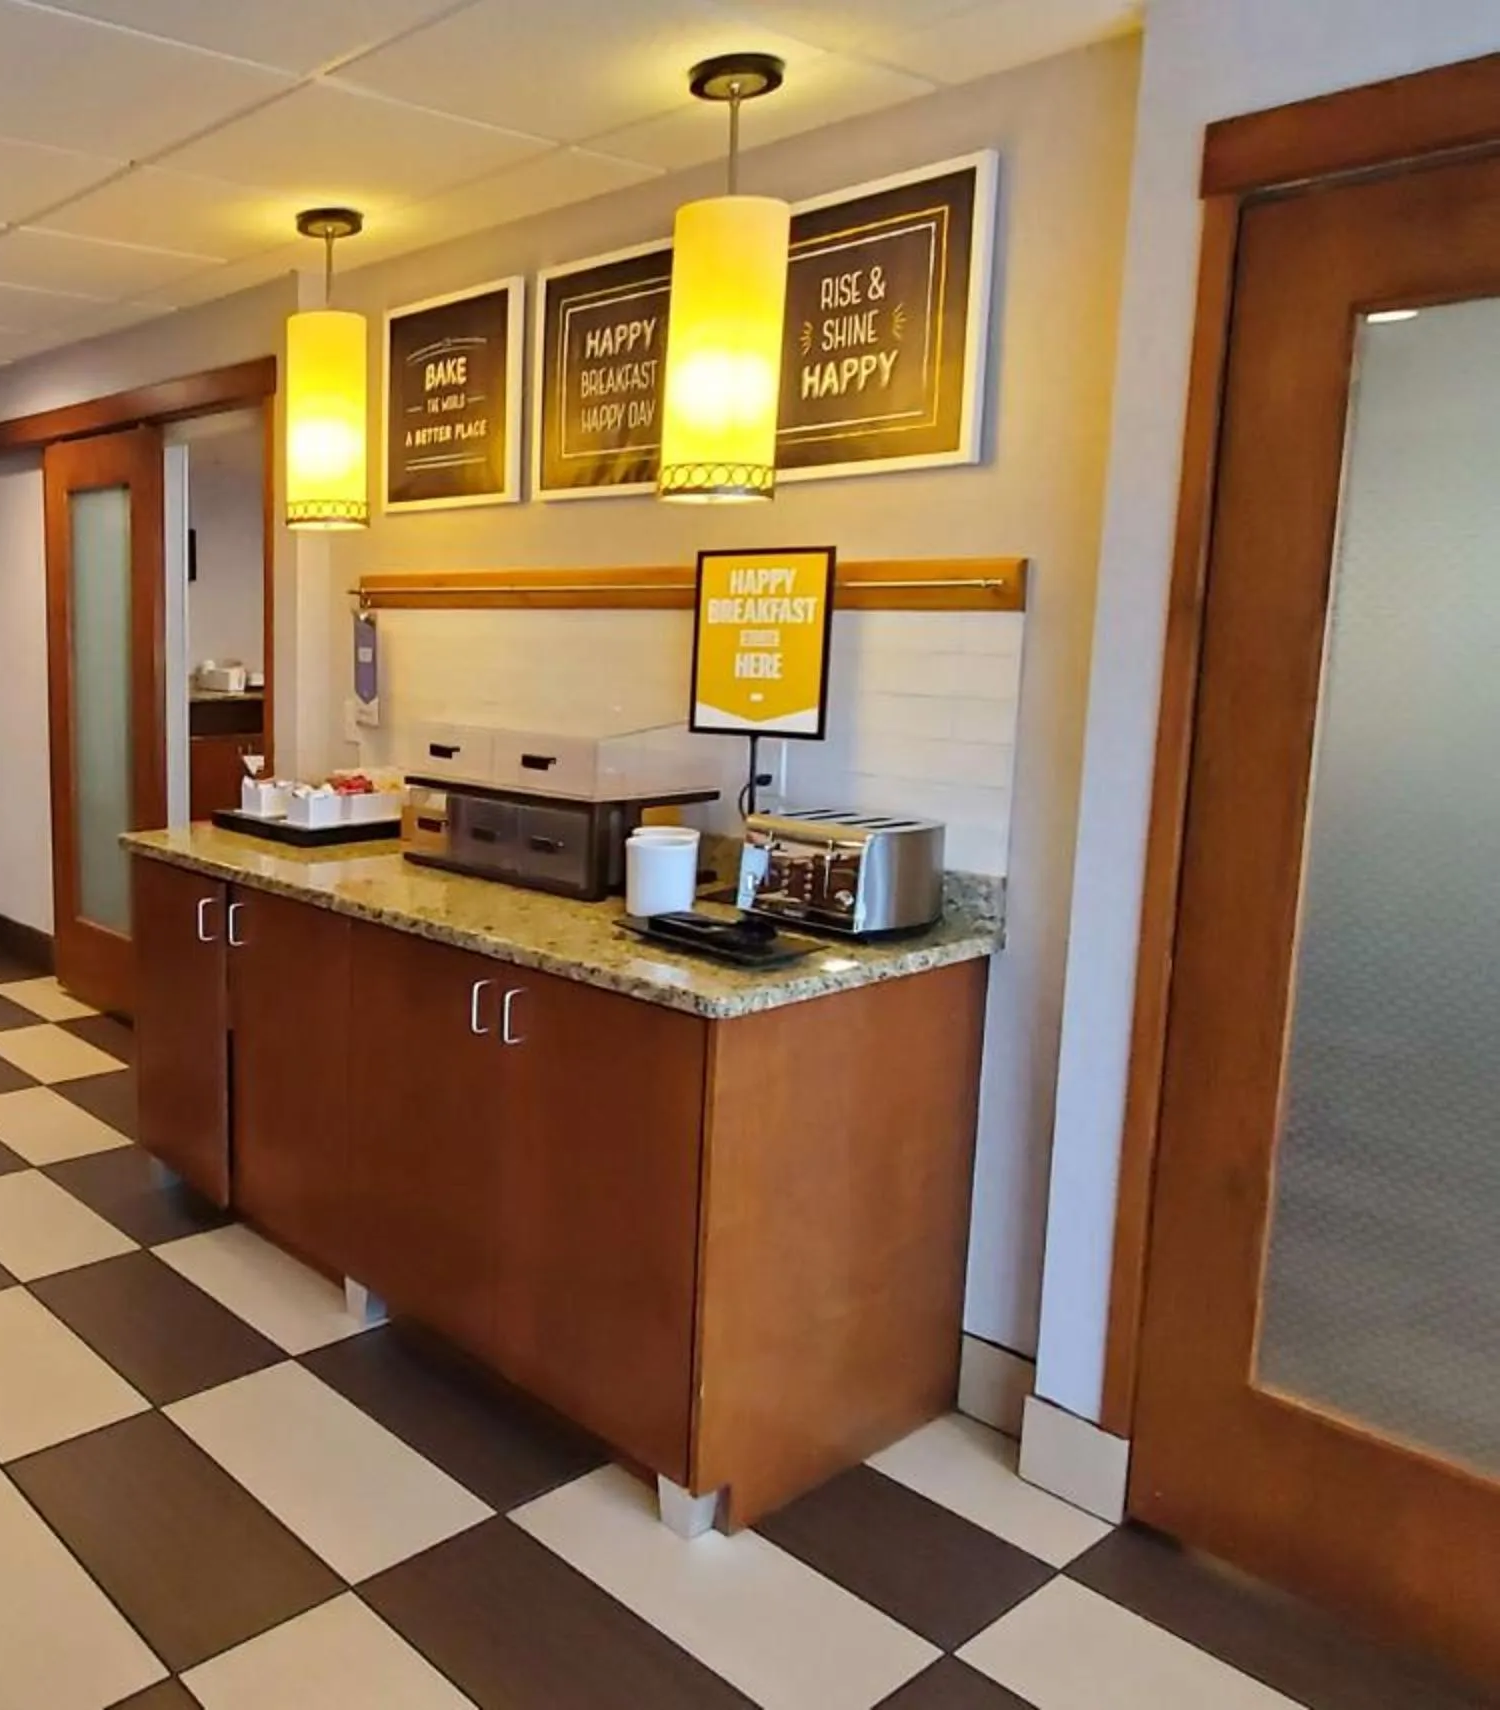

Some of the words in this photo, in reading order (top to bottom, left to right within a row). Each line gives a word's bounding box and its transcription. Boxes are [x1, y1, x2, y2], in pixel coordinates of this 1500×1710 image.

[820, 271, 862, 310] RISE
[867, 265, 886, 300] &
[585, 318, 656, 358] HAPPY
[821, 310, 879, 351] SHINE
[425, 356, 467, 392] BAKE
[581, 359, 658, 398] BREAKFAST
[801, 350, 898, 400] HAPPY
[405, 431, 412, 447] A
[415, 425, 452, 446] BETTER
[454, 419, 486, 440] PLACE
[581, 404, 623, 433] HAPPY
[627, 400, 656, 429] DAY
[730, 568, 797, 595] HAPPY
[707, 596, 818, 624] BREAKFAST
[734, 652, 783, 679] HERE
